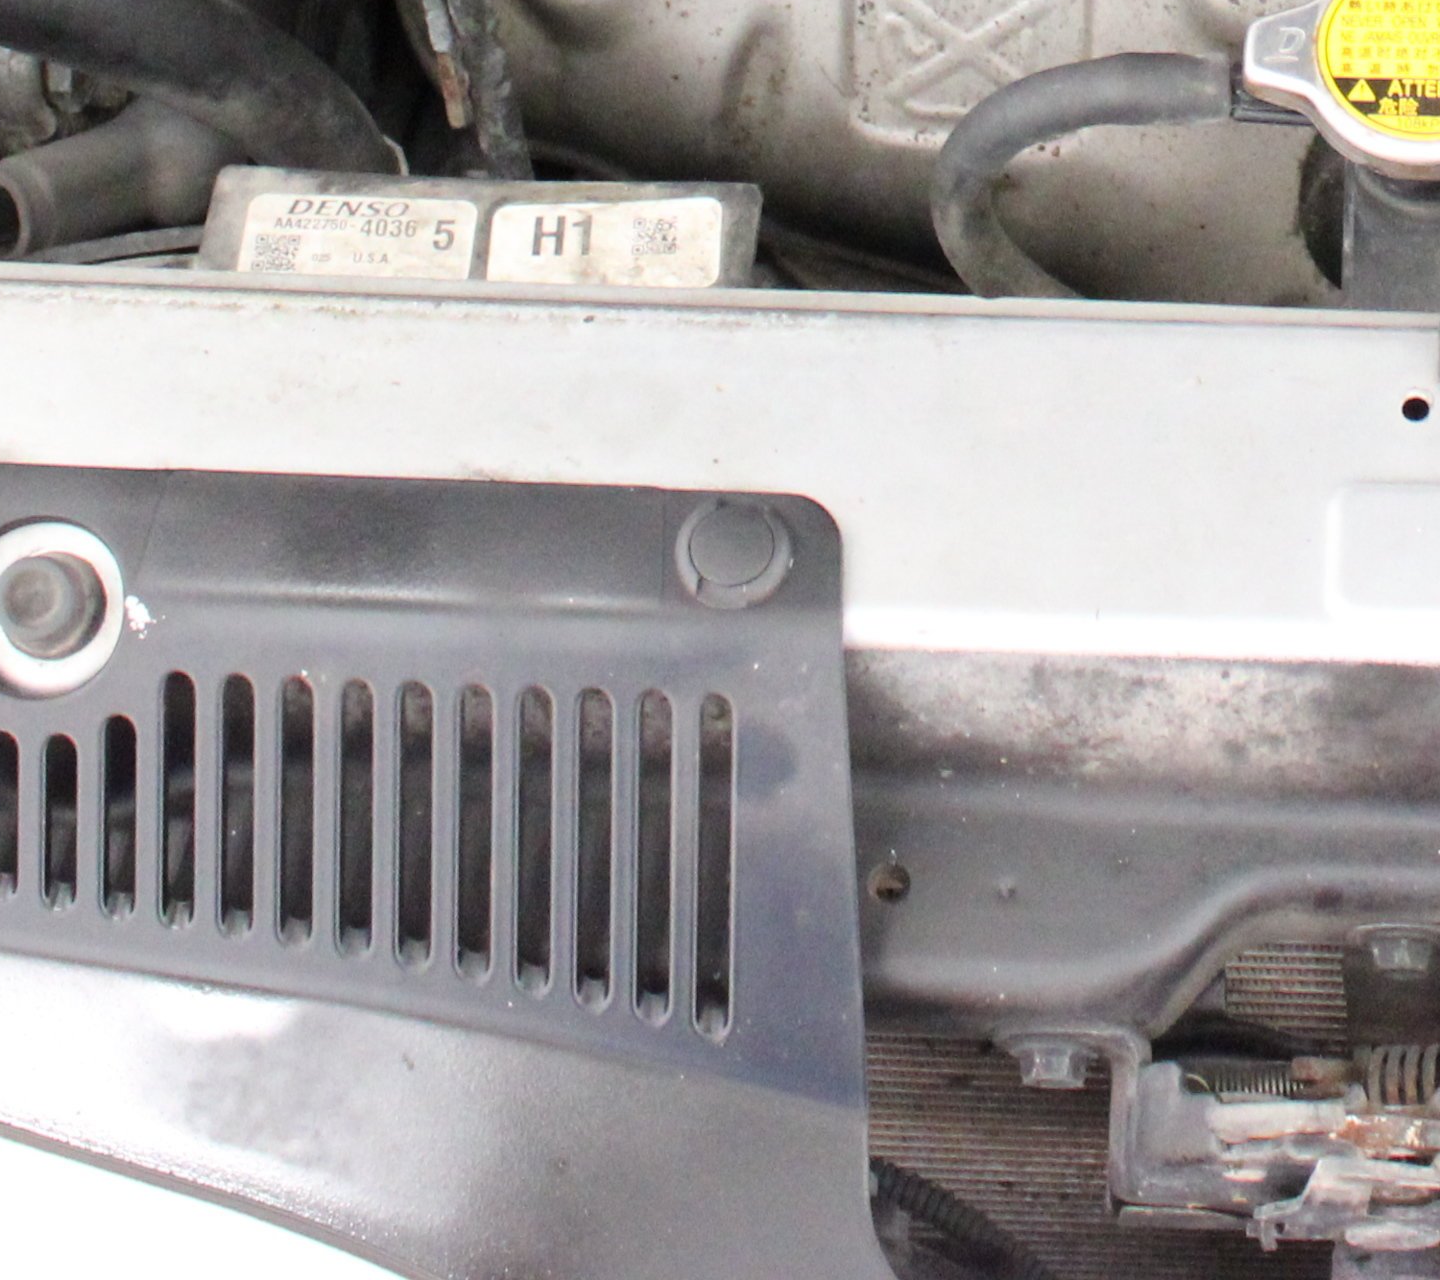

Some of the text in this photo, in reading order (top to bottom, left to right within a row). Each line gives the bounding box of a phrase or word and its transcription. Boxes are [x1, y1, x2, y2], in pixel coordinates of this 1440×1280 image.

[1341, 14, 1383, 28] NEVER
[1391, 16, 1427, 29] OPEN
[287, 199, 410, 218] DENSO
[431, 218, 457, 252] 5
[531, 215, 594, 257] H1
